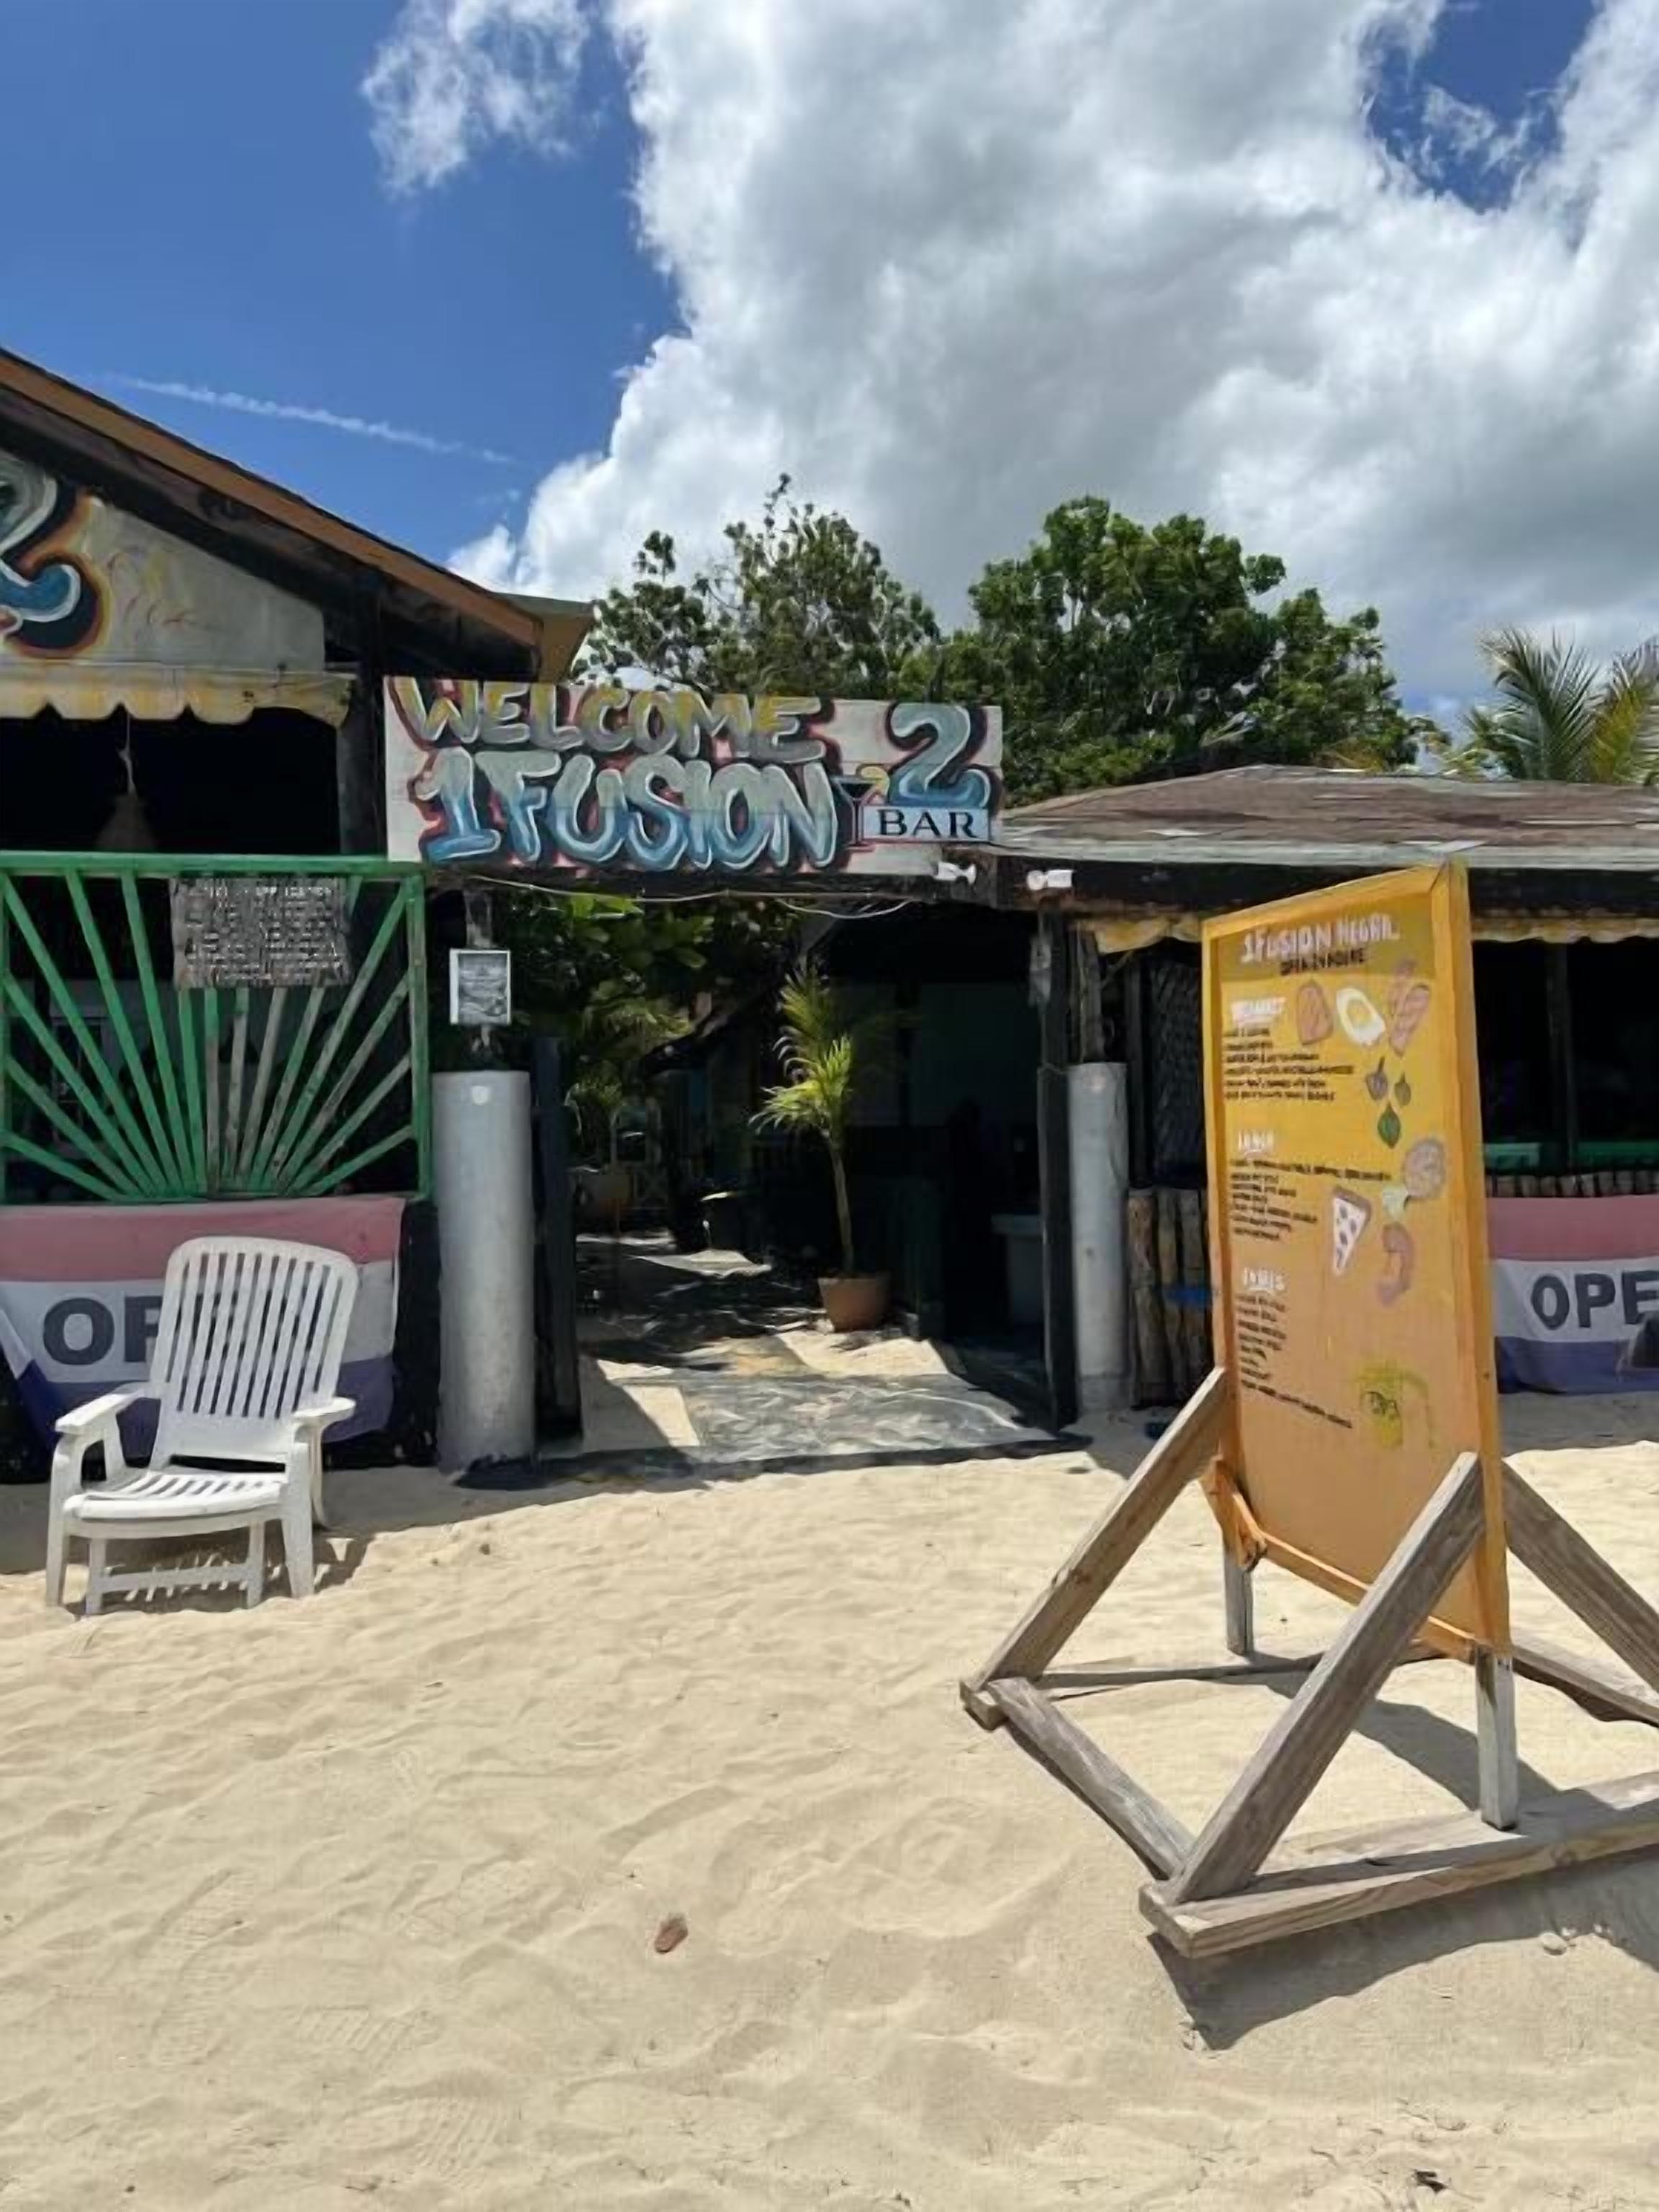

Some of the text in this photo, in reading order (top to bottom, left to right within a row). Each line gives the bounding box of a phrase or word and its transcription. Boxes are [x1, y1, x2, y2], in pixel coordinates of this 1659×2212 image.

[393, 675, 827, 764] WELCOME
[889, 701, 992, 806] 2
[878, 809, 979, 840] BAR
